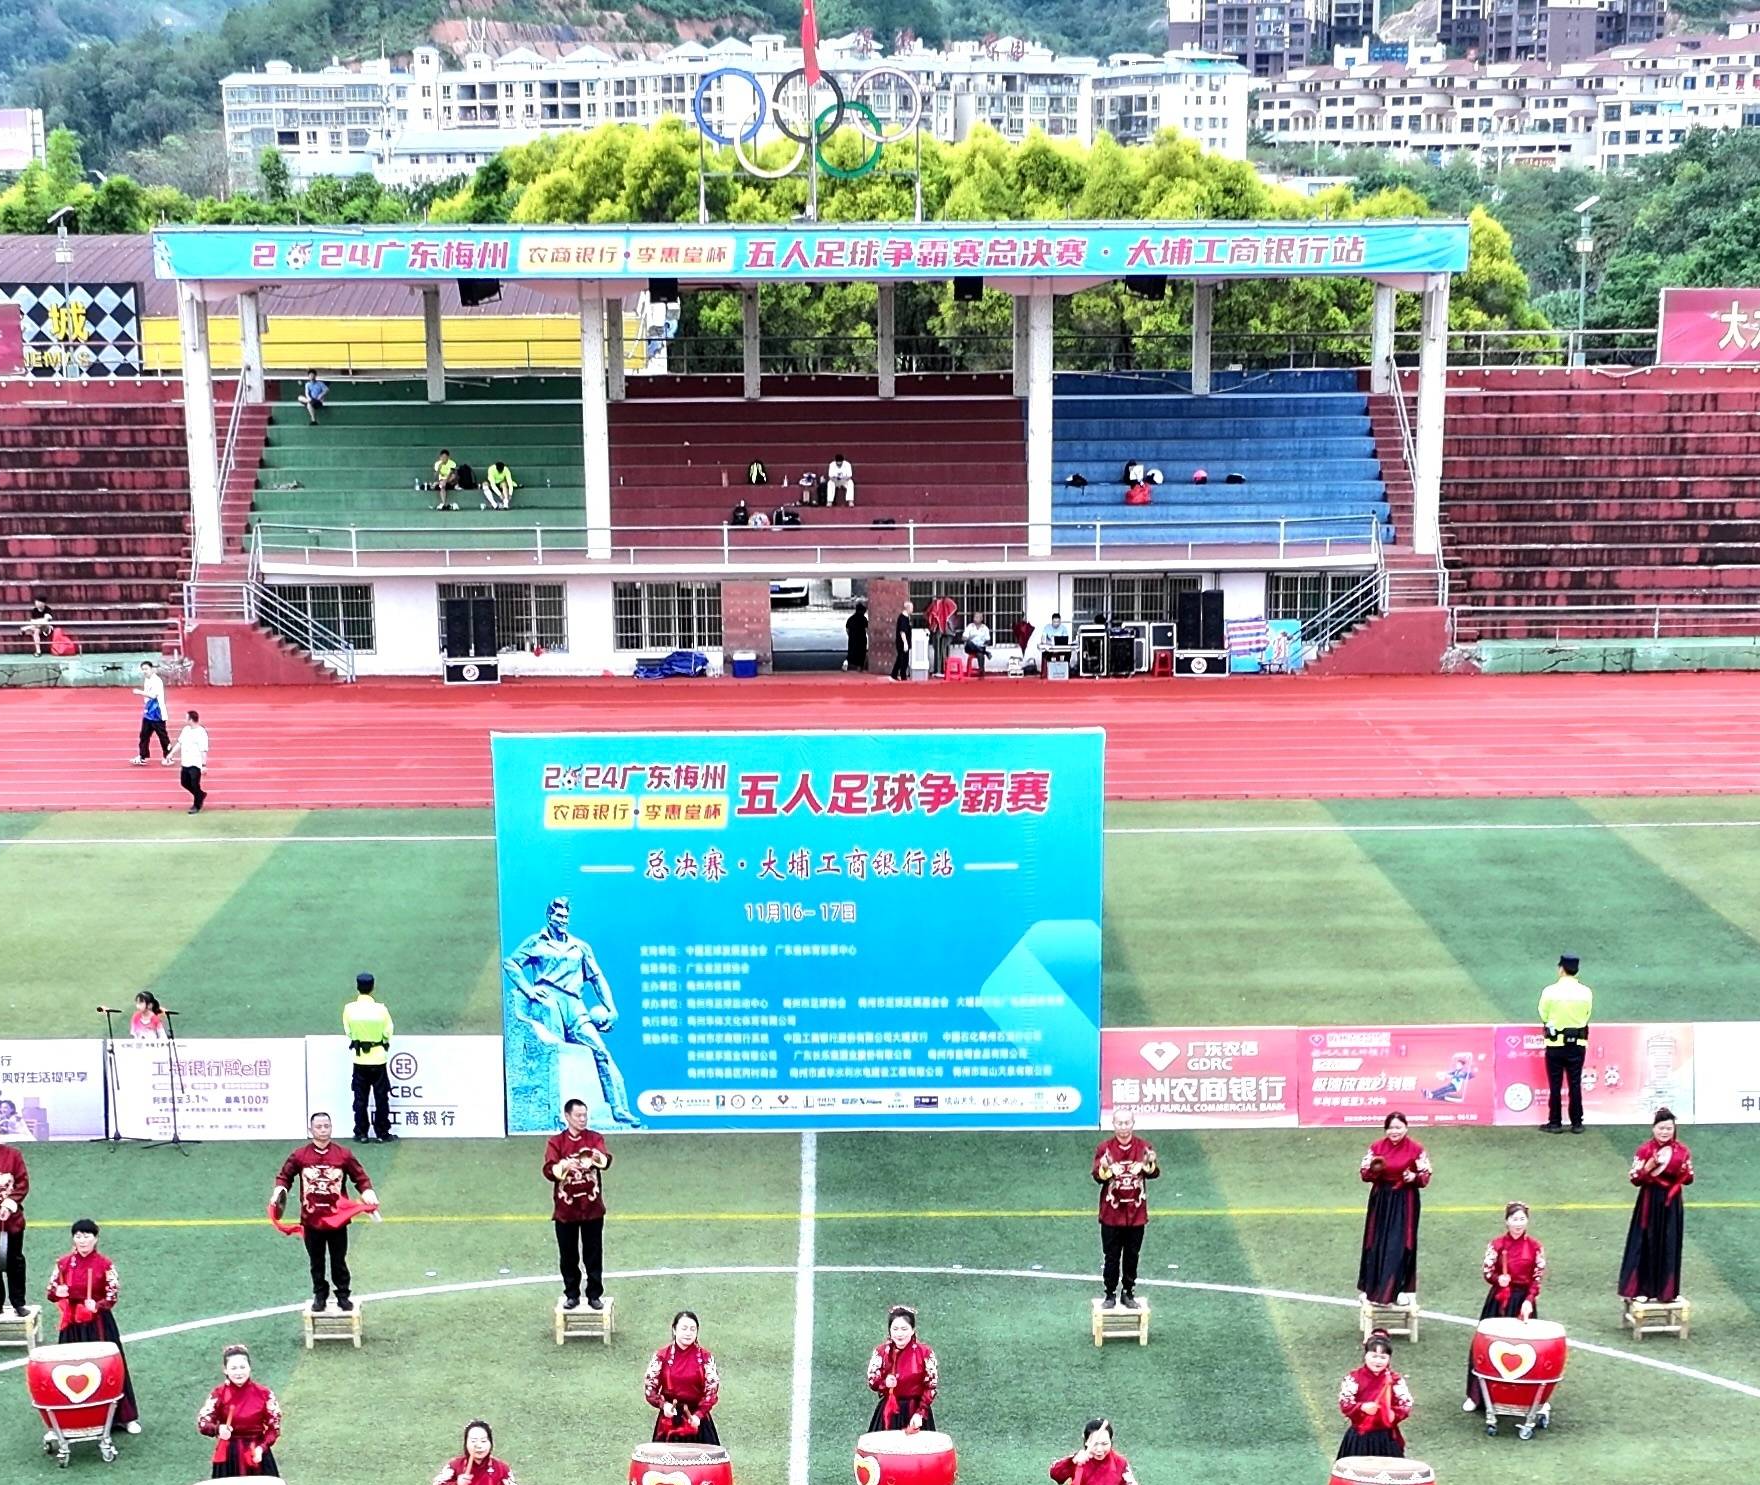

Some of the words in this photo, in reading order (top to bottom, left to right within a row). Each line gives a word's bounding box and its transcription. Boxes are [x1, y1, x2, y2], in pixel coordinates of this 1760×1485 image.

[736, 771, 1051, 816] 五人足球争霸赛
[1186, 1041, 1259, 1057] 广东农信
[1186, 1057, 1233, 1071] GDRC
[390, 1085, 424, 1098] CBC
[1112, 1076, 1287, 1103] 梅州农商银行
[1194, 1103, 1258, 1112] COMMERCIAL
[1259, 1102, 1286, 1111] BANK
[371, 1110, 456, 1126] 工商银行
